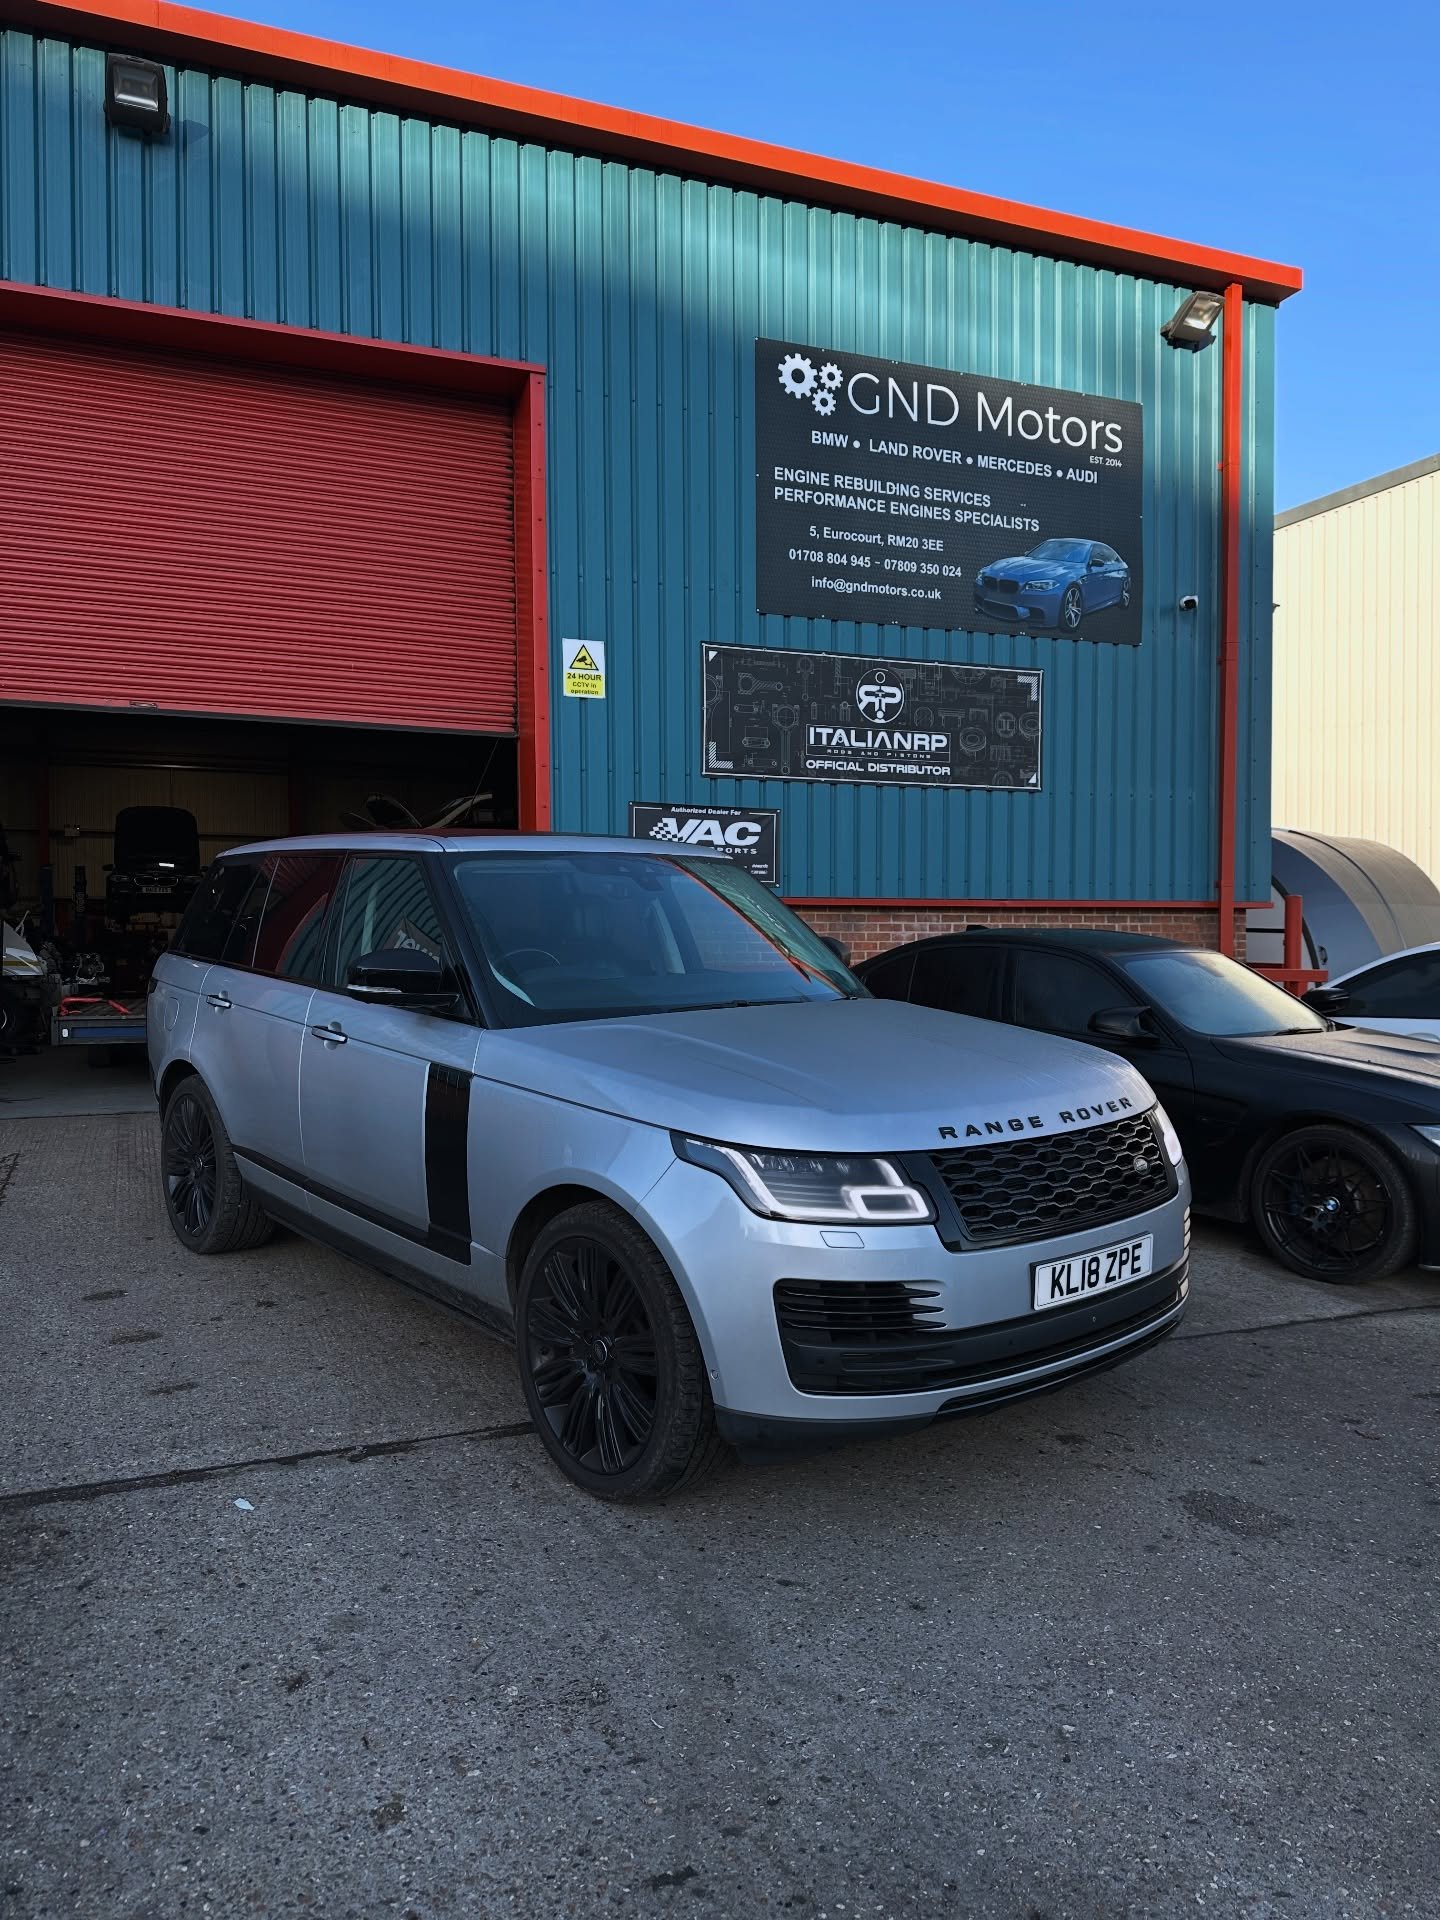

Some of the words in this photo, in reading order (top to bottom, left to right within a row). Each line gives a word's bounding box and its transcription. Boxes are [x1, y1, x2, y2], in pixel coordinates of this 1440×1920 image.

[847, 372, 959, 426] GND
[977, 391, 1123, 453] Motors
[811, 430, 849, 448] BMW
[869, 439, 909, 457] LAND
[912, 445, 962, 465] ROVER
[977, 454, 1052, 478] MERCEDES
[1066, 467, 1098, 484] AUDI
[1089, 455, 1104, 465] EST.
[1105, 457, 1122, 468] 2014
[774, 466, 830, 487] ENGINE
[834, 474, 920, 499] REBUILDING
[923, 486, 991, 508] SERVICES
[774, 486, 886, 513] PERFORMANCE
[890, 501, 951, 521] ENGINES
[954, 509, 1040, 532] SPECIALISTS
[809, 525, 820, 539] 5,
[823, 526, 884, 547] Eurocourt,
[887, 534, 919, 549] RM20
[921, 538, 944, 551] 3EE
[788, 548, 824, 563] 01708
[827, 552, 848, 566] 804
[850, 555, 871, 568] 945
[884, 559, 917, 573] 07809
[920, 562, 940, 575] 350
[942, 564, 962, 578] 024
[811, 575, 942, 600] info@gndmotors.co.uk
[578, 673, 602, 681] HOUR
[809, 726, 948, 751] ITALIANRP
[805, 759, 865, 772] OFFICIAL
[867, 762, 951, 776] DISTRIBUTOR
[886, 751, 932, 759] PISTONS
[671, 806, 707, 815] Authorized
[708, 808, 729, 816] Dealer
[730, 809, 742, 817] For
[657, 816, 762, 846] VAC
[938, 1115, 1044, 1140] RANGE
[1059, 1096, 1133, 1124] ROVER
[1050, 1255, 1100, 1300] KL18
[1105, 1242, 1143, 1284] ZPE
